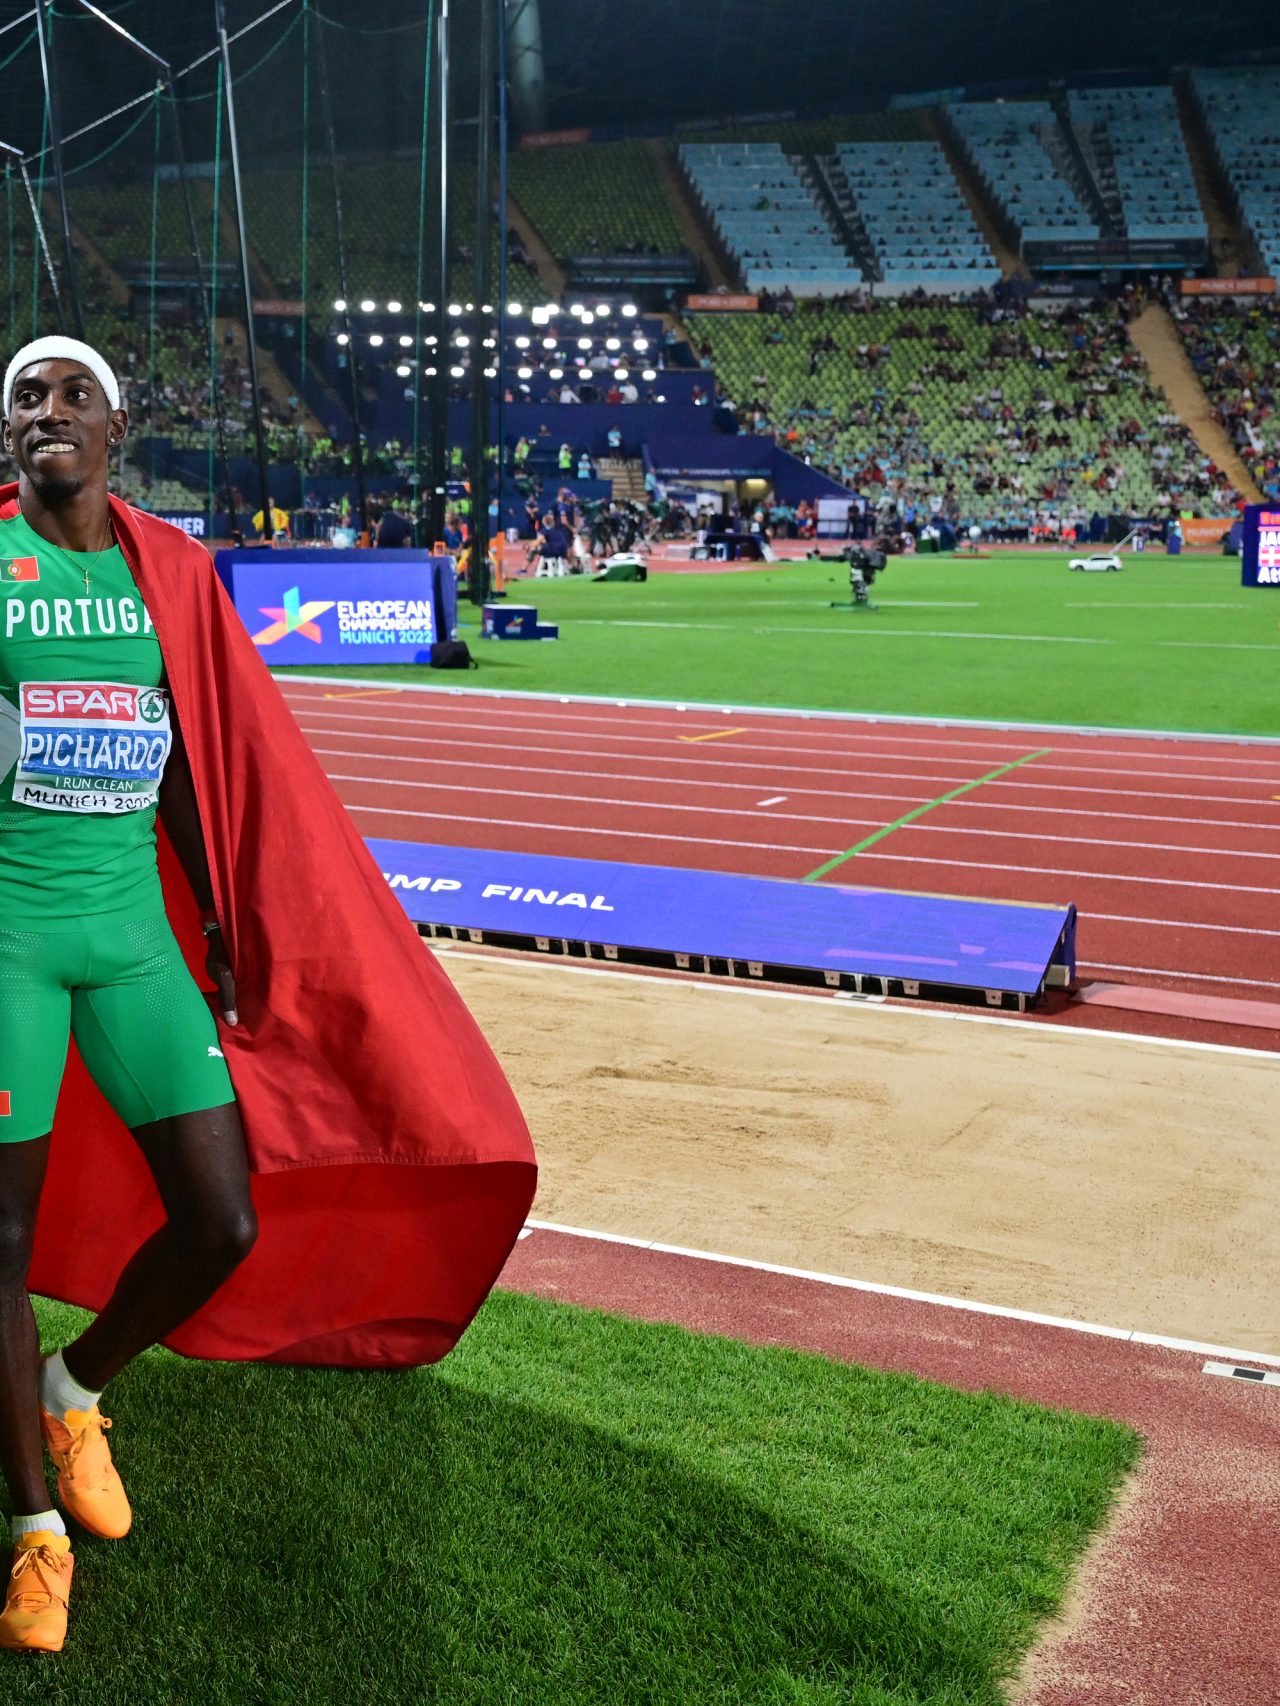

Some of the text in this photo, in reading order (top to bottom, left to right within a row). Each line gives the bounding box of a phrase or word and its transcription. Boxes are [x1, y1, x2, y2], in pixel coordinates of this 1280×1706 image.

[336, 600, 431, 620] EUROPEAN
[338, 618, 432, 631] CHAMPIONSHIPS
[340, 630, 433, 644] MUNICH 2022
[27, 689, 134, 717] SPAR
[23, 732, 166, 771] PICHARDO
[55, 775, 133, 791] I RUN CLEAN
[23, 786, 107, 808] MUNICH
[481, 884, 614, 911] FINAL
